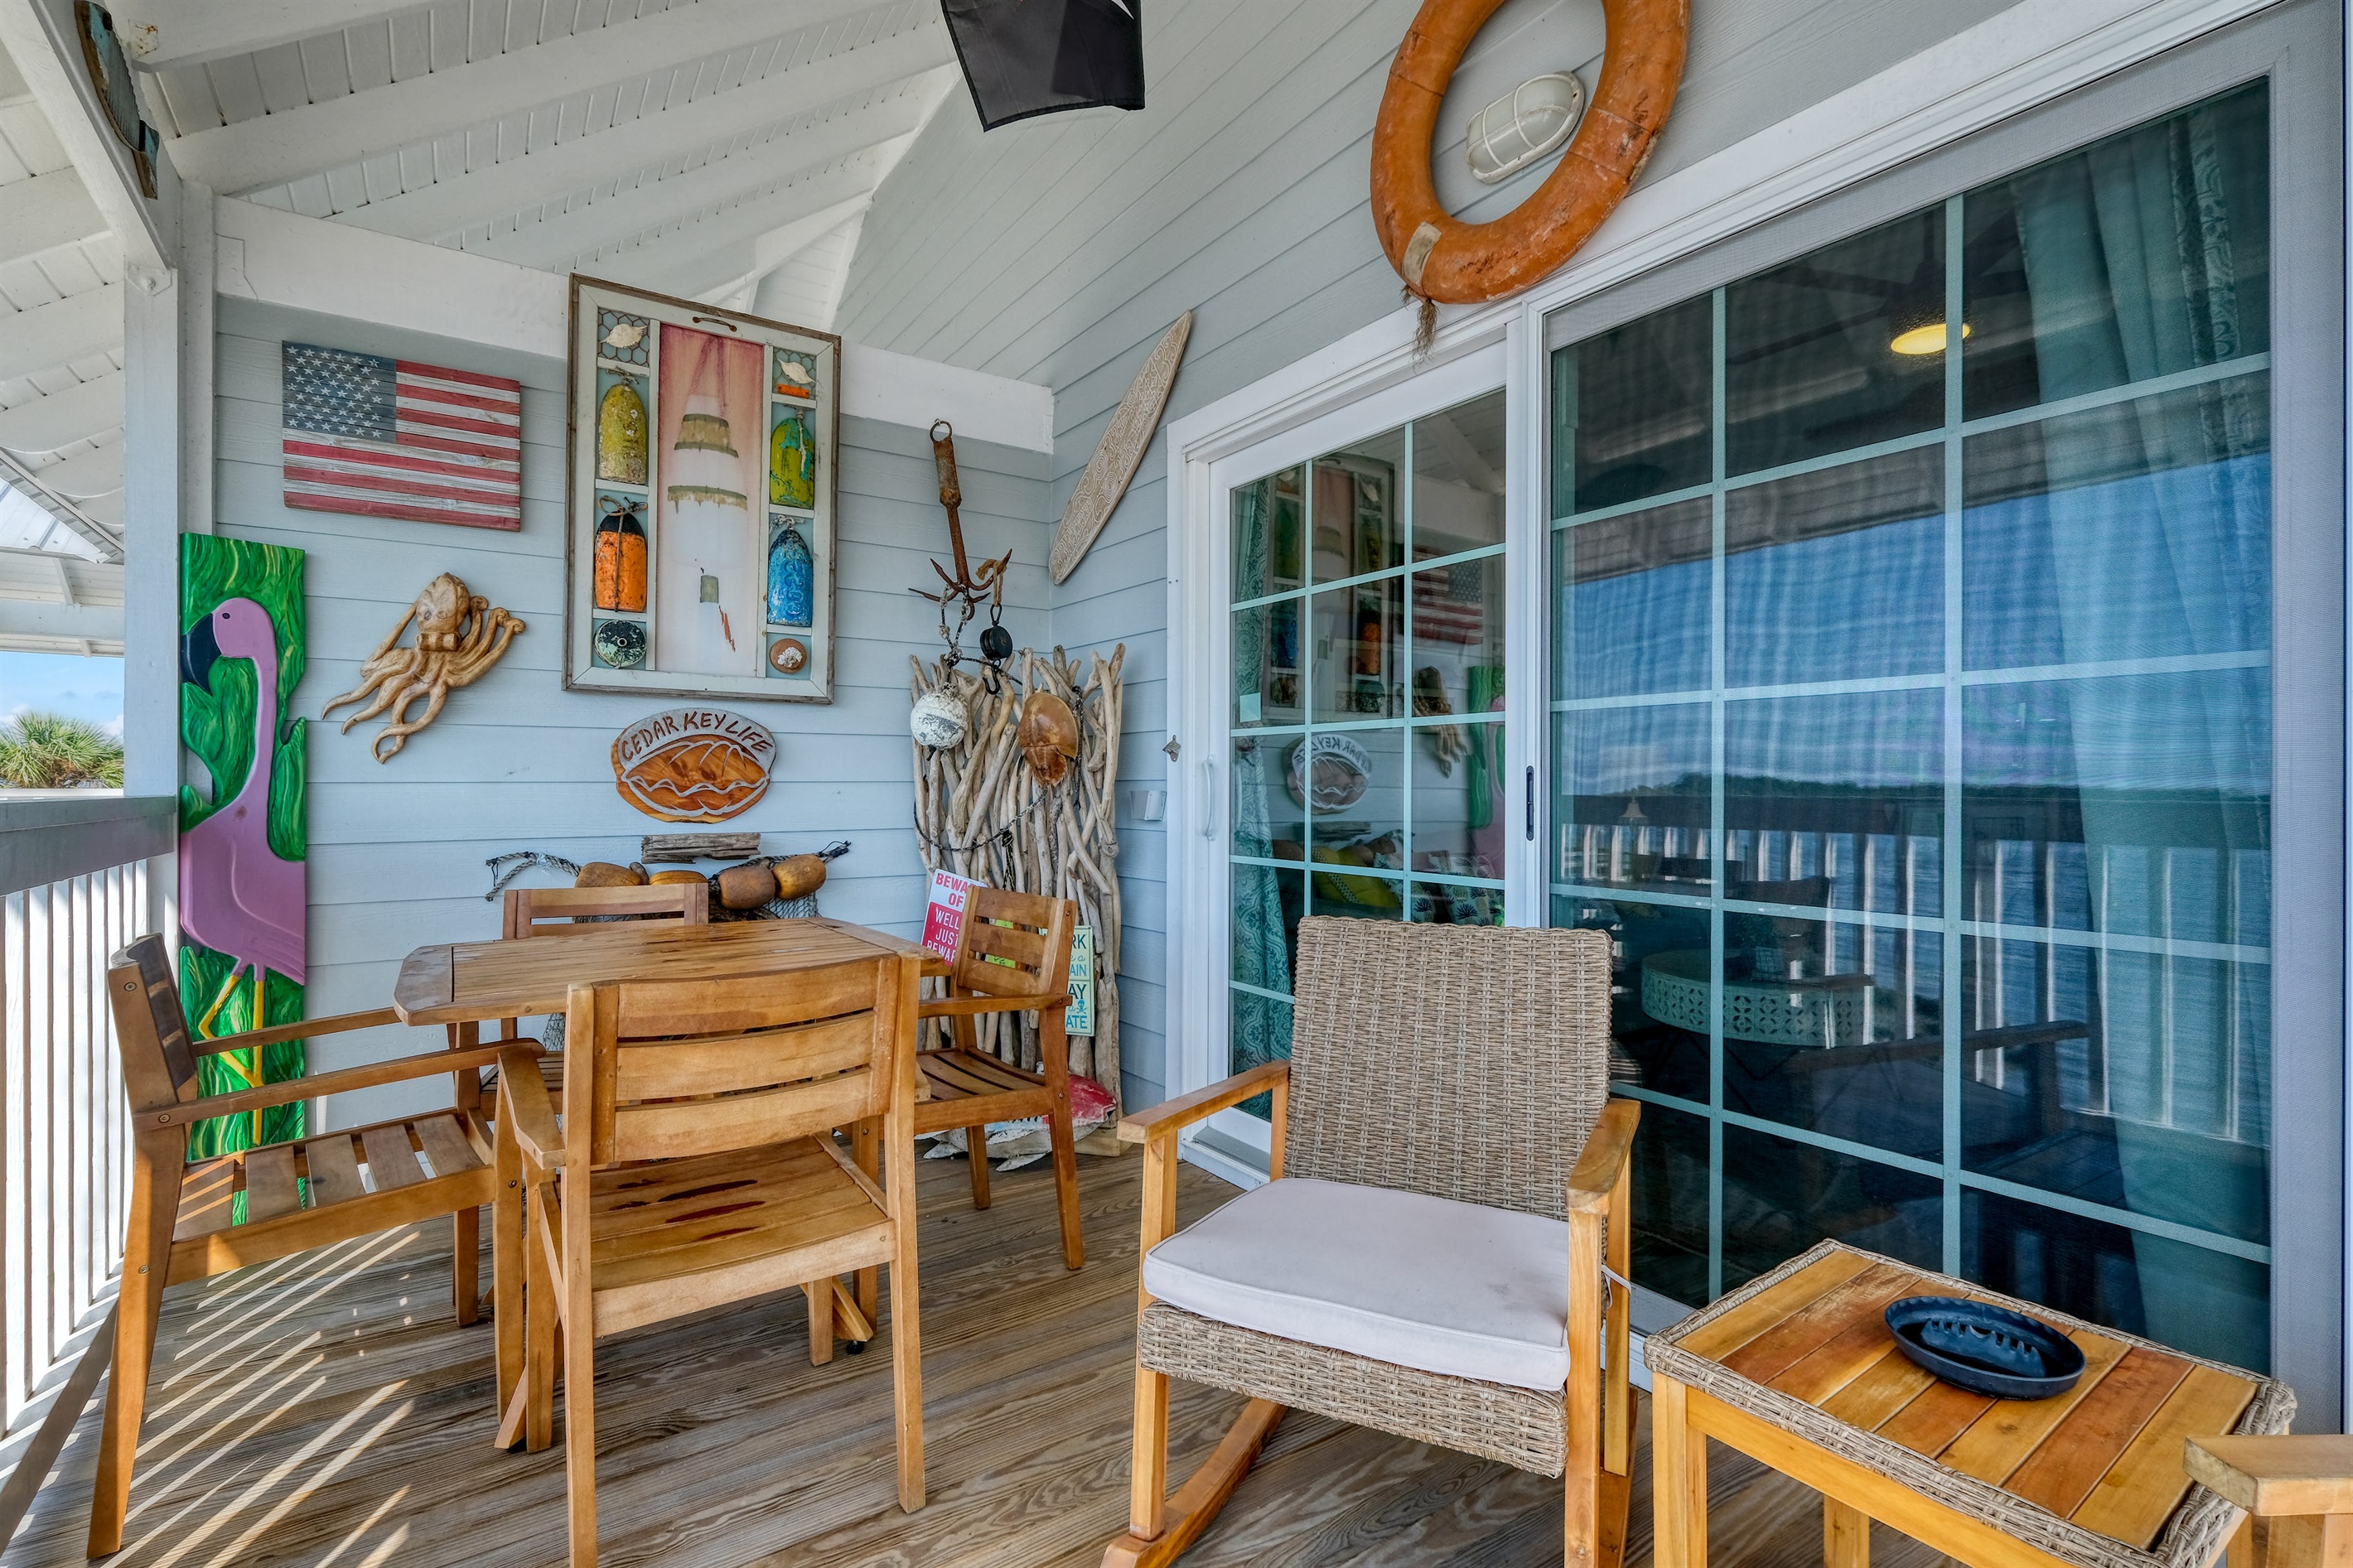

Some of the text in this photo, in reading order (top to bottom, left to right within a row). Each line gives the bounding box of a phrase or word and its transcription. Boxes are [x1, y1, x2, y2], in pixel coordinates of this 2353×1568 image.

[622, 711, 773, 761] CEDAR KEY LIFE
[935, 873, 968, 894] BEWA
[948, 893, 964, 907] OF
[1072, 934, 1087, 948] RK
[927, 940, 955, 962] BEWAR
[1070, 964, 1086, 976] AIN
[1068, 984, 1086, 999] AY
[1065, 1015, 1087, 1029] ATE
